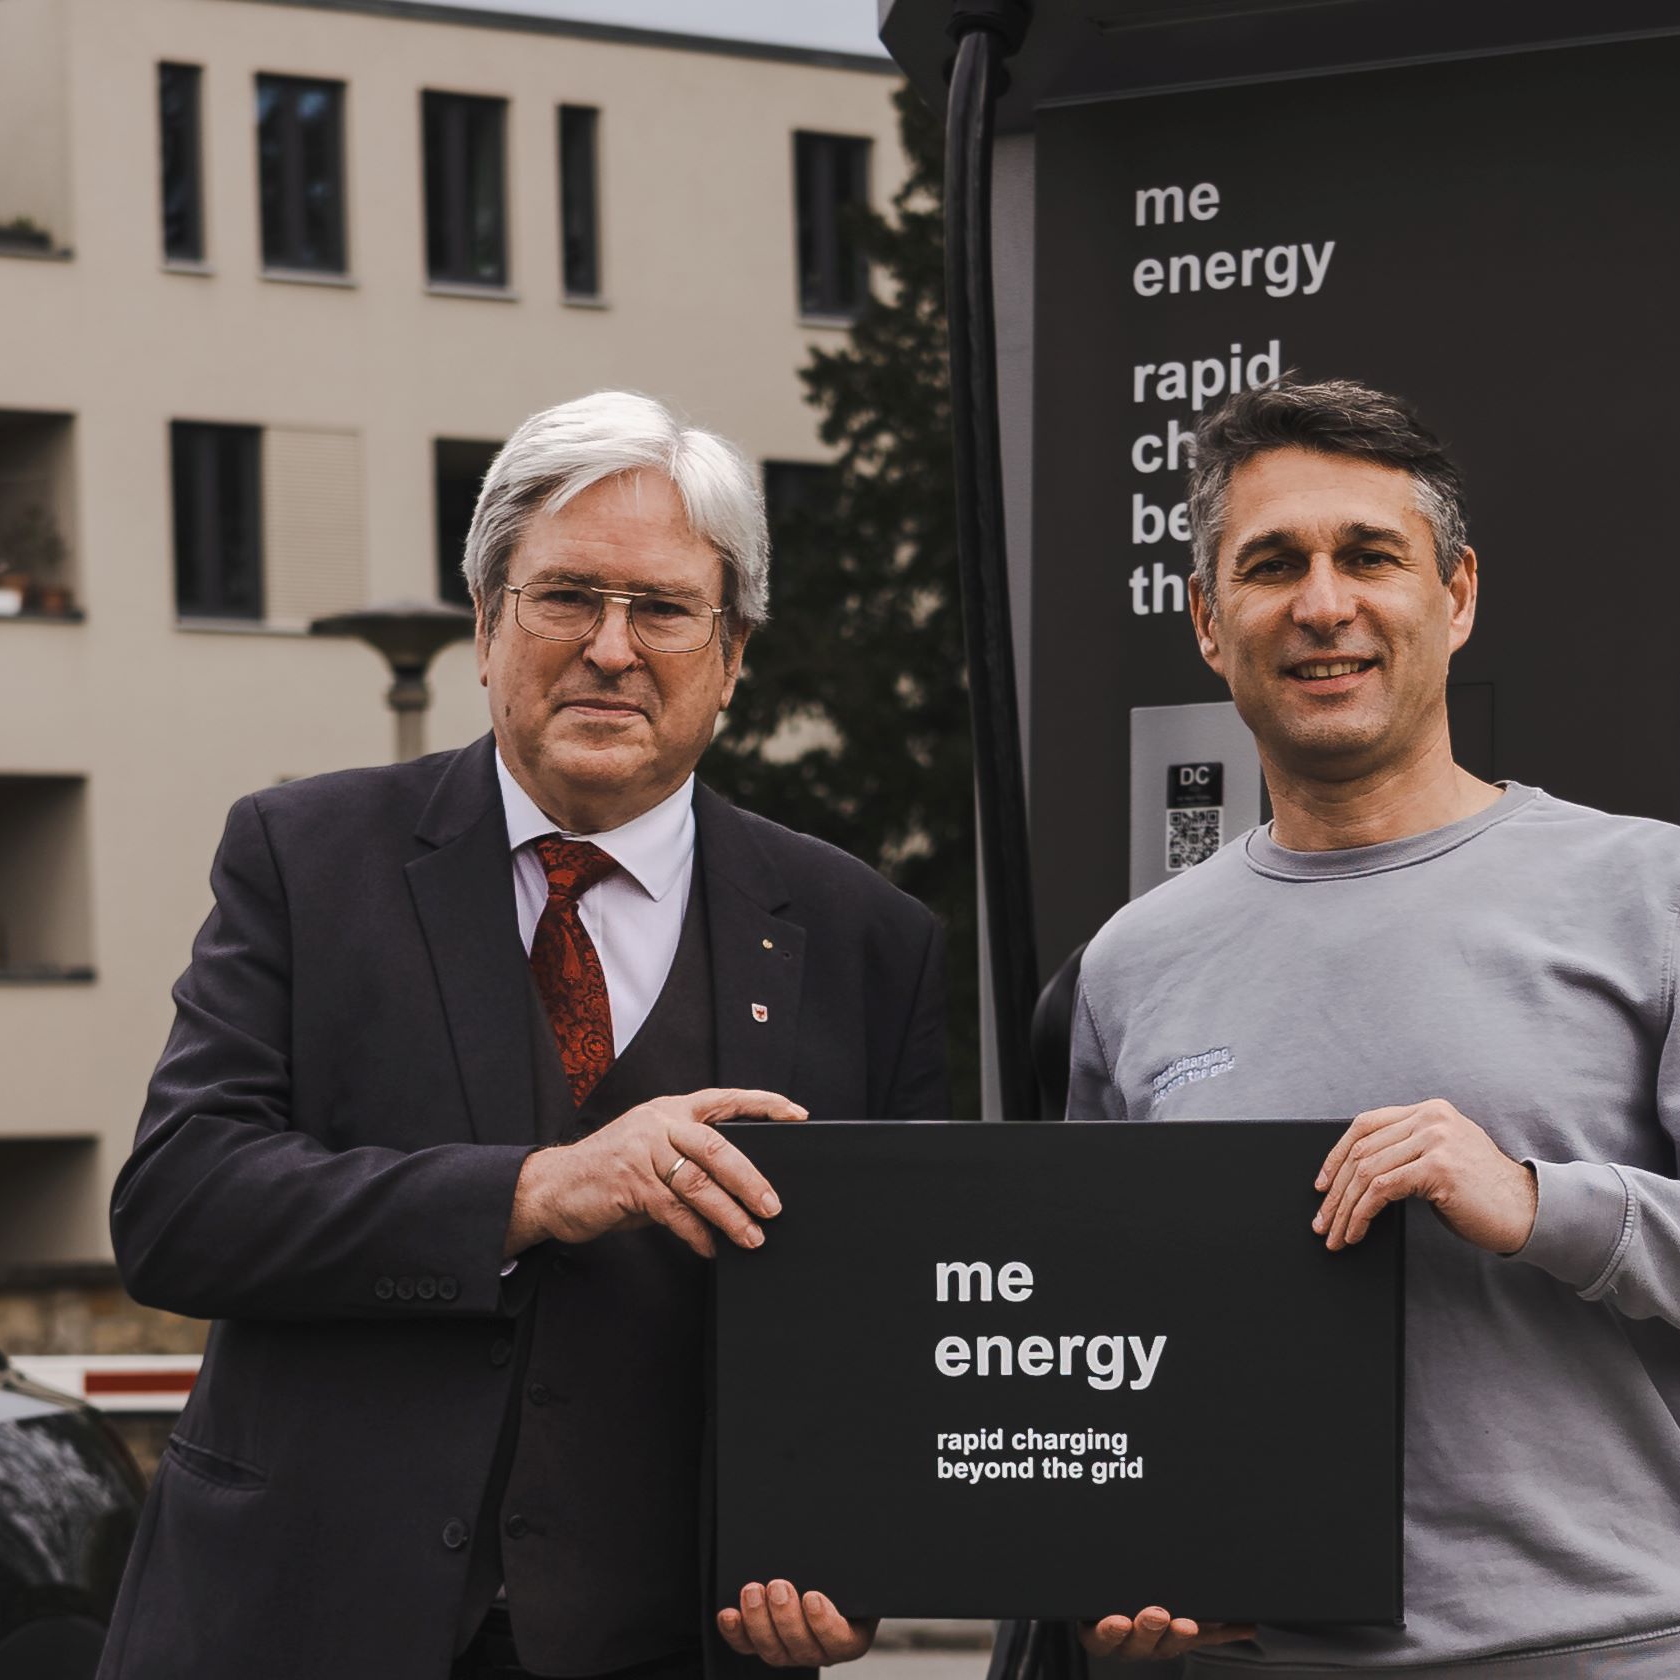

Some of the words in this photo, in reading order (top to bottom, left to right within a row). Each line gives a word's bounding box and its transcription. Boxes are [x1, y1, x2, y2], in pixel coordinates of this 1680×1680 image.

[1135, 182, 1221, 227] me
[1133, 240, 1336, 298] energy
[1133, 340, 1280, 411] rapid
[1179, 766, 1210, 786] DC
[936, 1261, 1034, 1302] me
[934, 1334, 1168, 1390] energy
[937, 1428, 1004, 1455] rapid
[1011, 1428, 1128, 1455] charging
[937, 1456, 1034, 1485] beyond
[1041, 1456, 1084, 1480] the
[1090, 1456, 1144, 1485] grid
